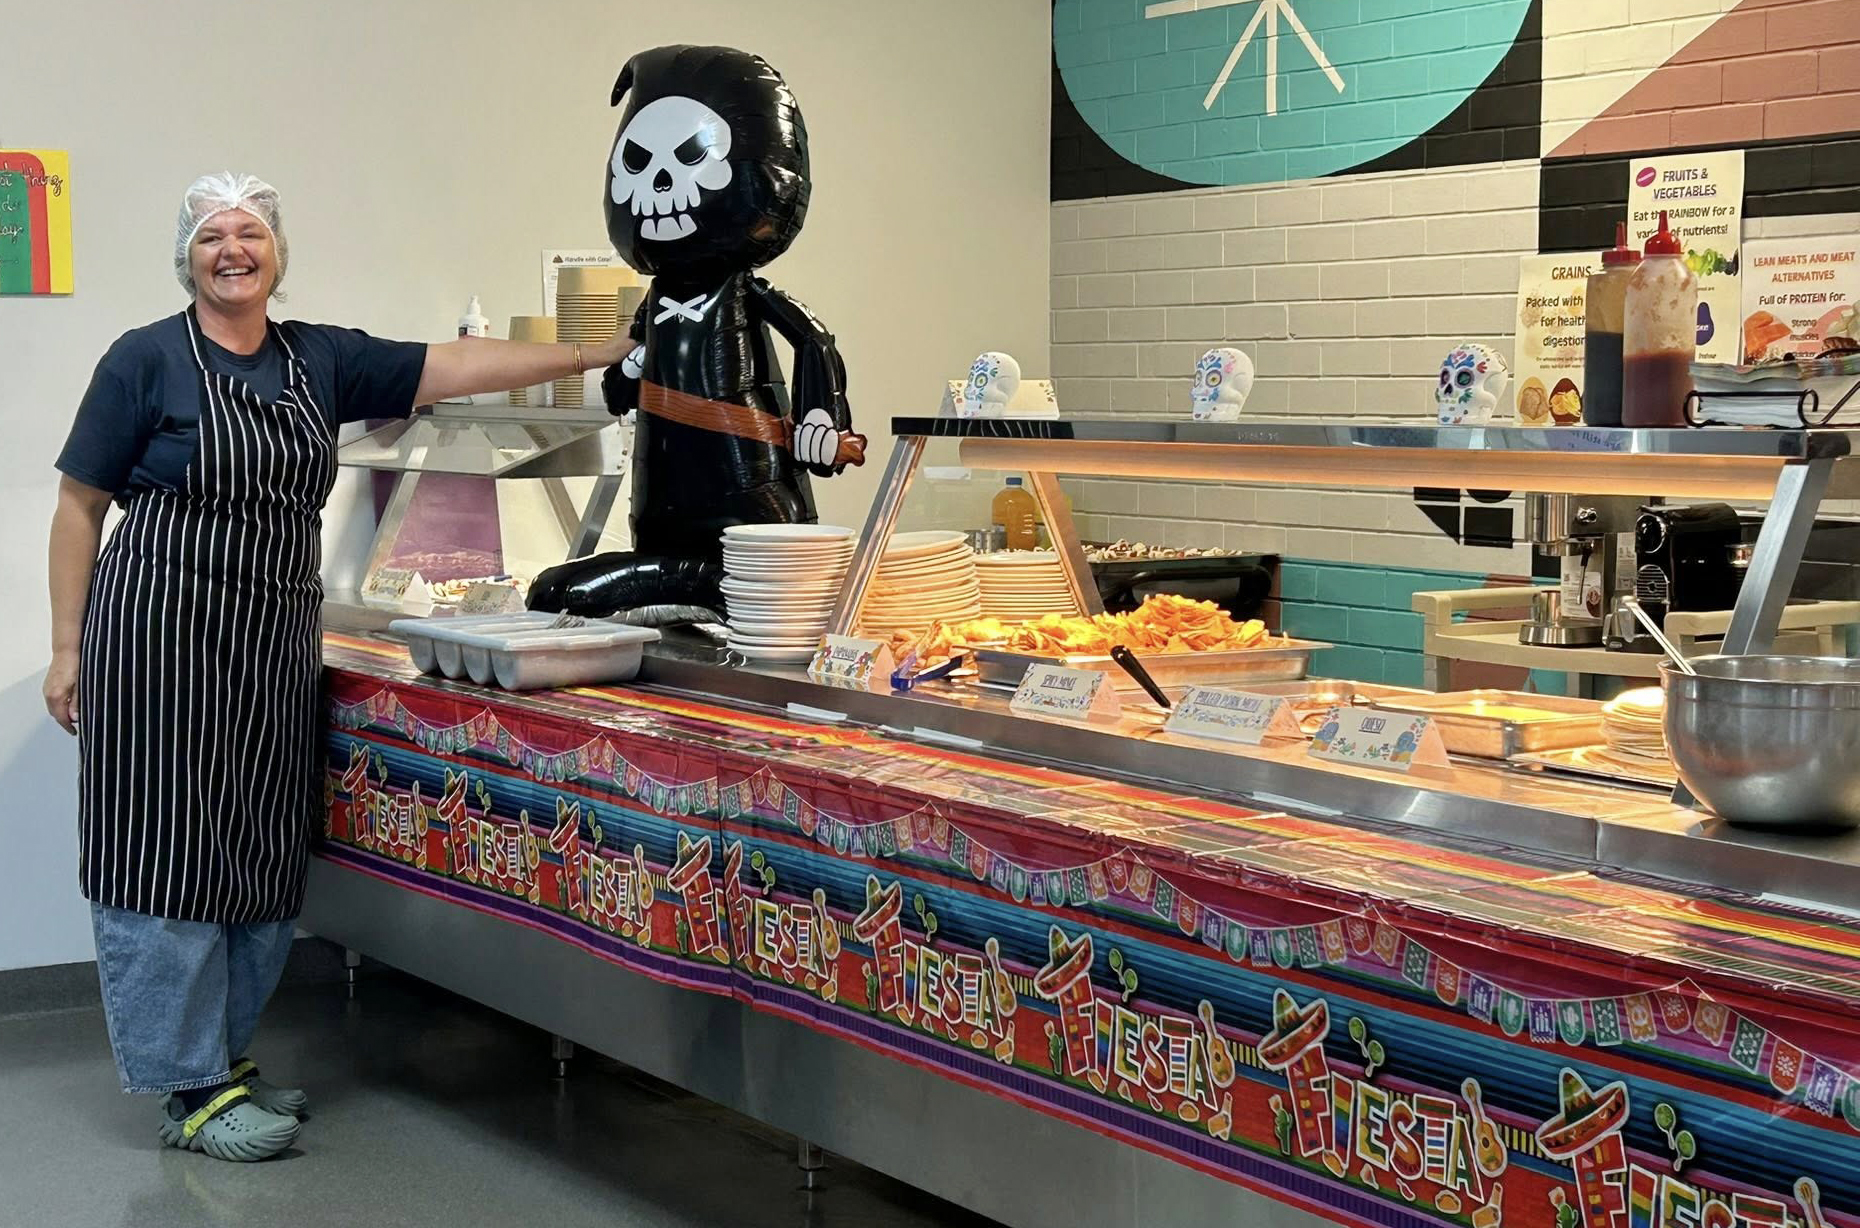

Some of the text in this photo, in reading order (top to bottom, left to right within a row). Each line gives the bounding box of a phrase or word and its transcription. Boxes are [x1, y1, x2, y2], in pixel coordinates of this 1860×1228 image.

[1663, 168, 1709, 182] FRUITS &
[1653, 184, 1717, 199] VEGETABLES
[1633, 206, 1736, 221] Eat th RAINBOW for a
[1671, 227, 1681, 237] of
[1683, 225, 1729, 237] nutrients!
[1754, 251, 1856, 267] LEAN MEATS AND MEAT
[1552, 266, 1592, 280] GRAINS
[1772, 270, 1835, 283] ALTERNATIVES
[1526, 295, 1584, 308] Packed with
[1759, 295, 1775, 306] Full
[1777, 294, 1787, 304] of
[1789, 293, 1827, 304] PROTEIN
[1541, 315, 1586, 327] for health
[349, 773, 421, 852] FIESTA
[450, 799, 534, 884] FIESTA
[561, 831, 644, 927] FIESTA
[874, 917, 1003, 1037] FIESTA
[1059, 973, 1219, 1111] FIESTA
[1286, 1043, 1485, 1204] FIESTA
